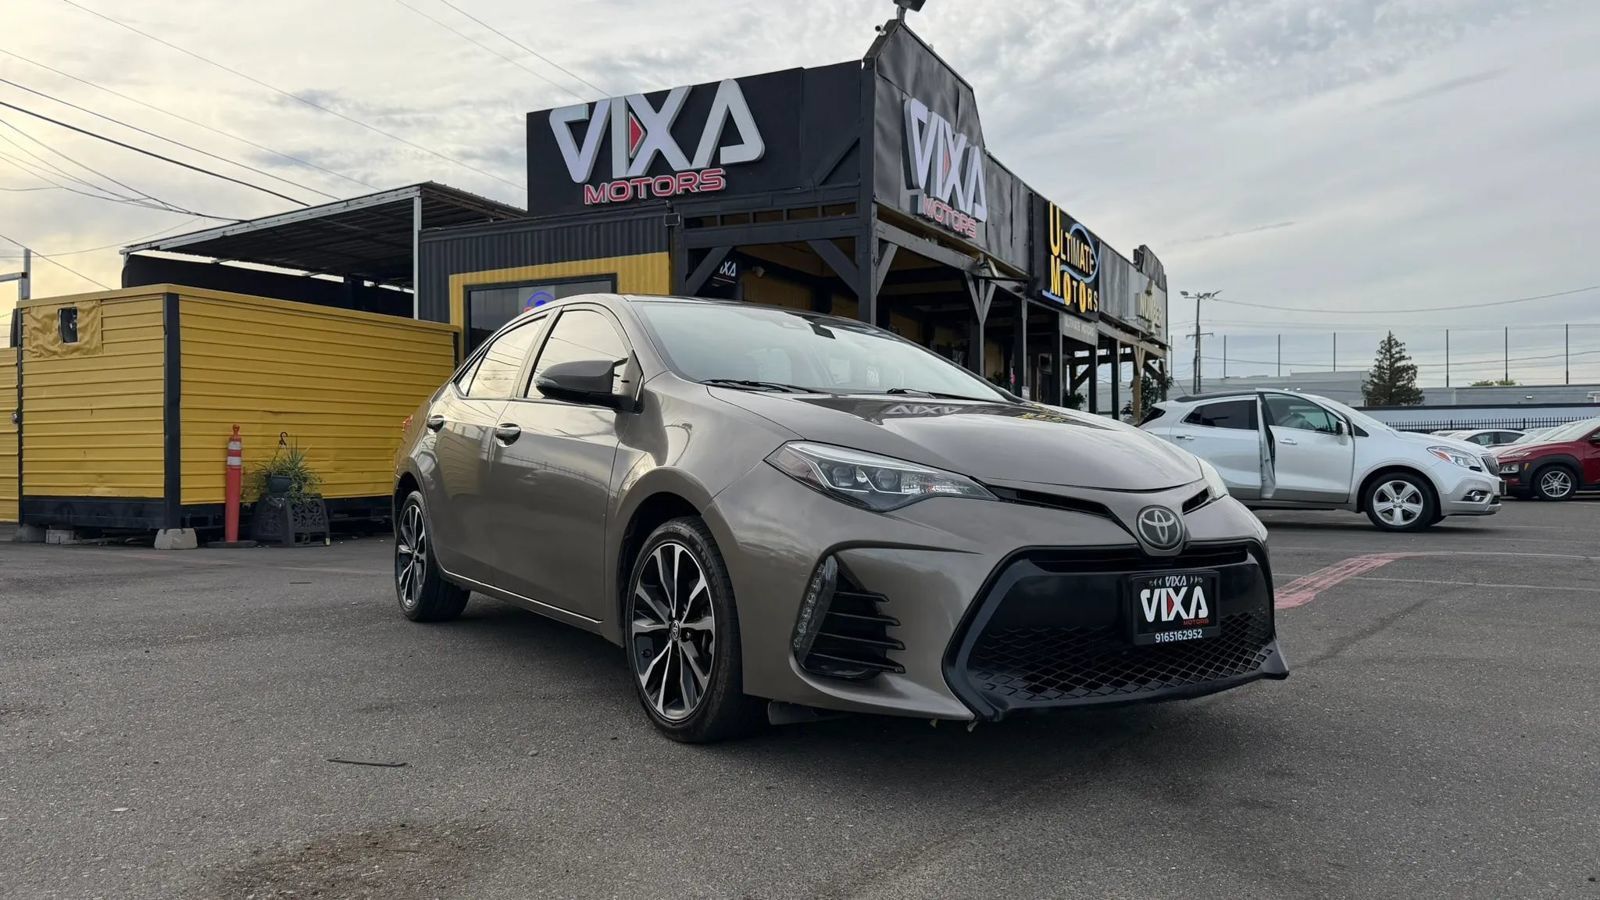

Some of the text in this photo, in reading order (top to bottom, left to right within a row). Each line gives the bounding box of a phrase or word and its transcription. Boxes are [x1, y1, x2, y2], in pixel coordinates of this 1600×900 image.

[549, 79, 765, 183] VIXA
[904, 98, 988, 222] VIXA
[584, 168, 726, 205] MOTORS
[923, 194, 977, 239] MOTORS
[1050, 202, 1094, 275] ULTIMATE
[1051, 255, 1098, 313] MOTORS
[1165, 575, 1187, 587] VIXA
[1140, 585, 1208, 623] VIXA
[1155, 629, 1202, 643] 9165162952
